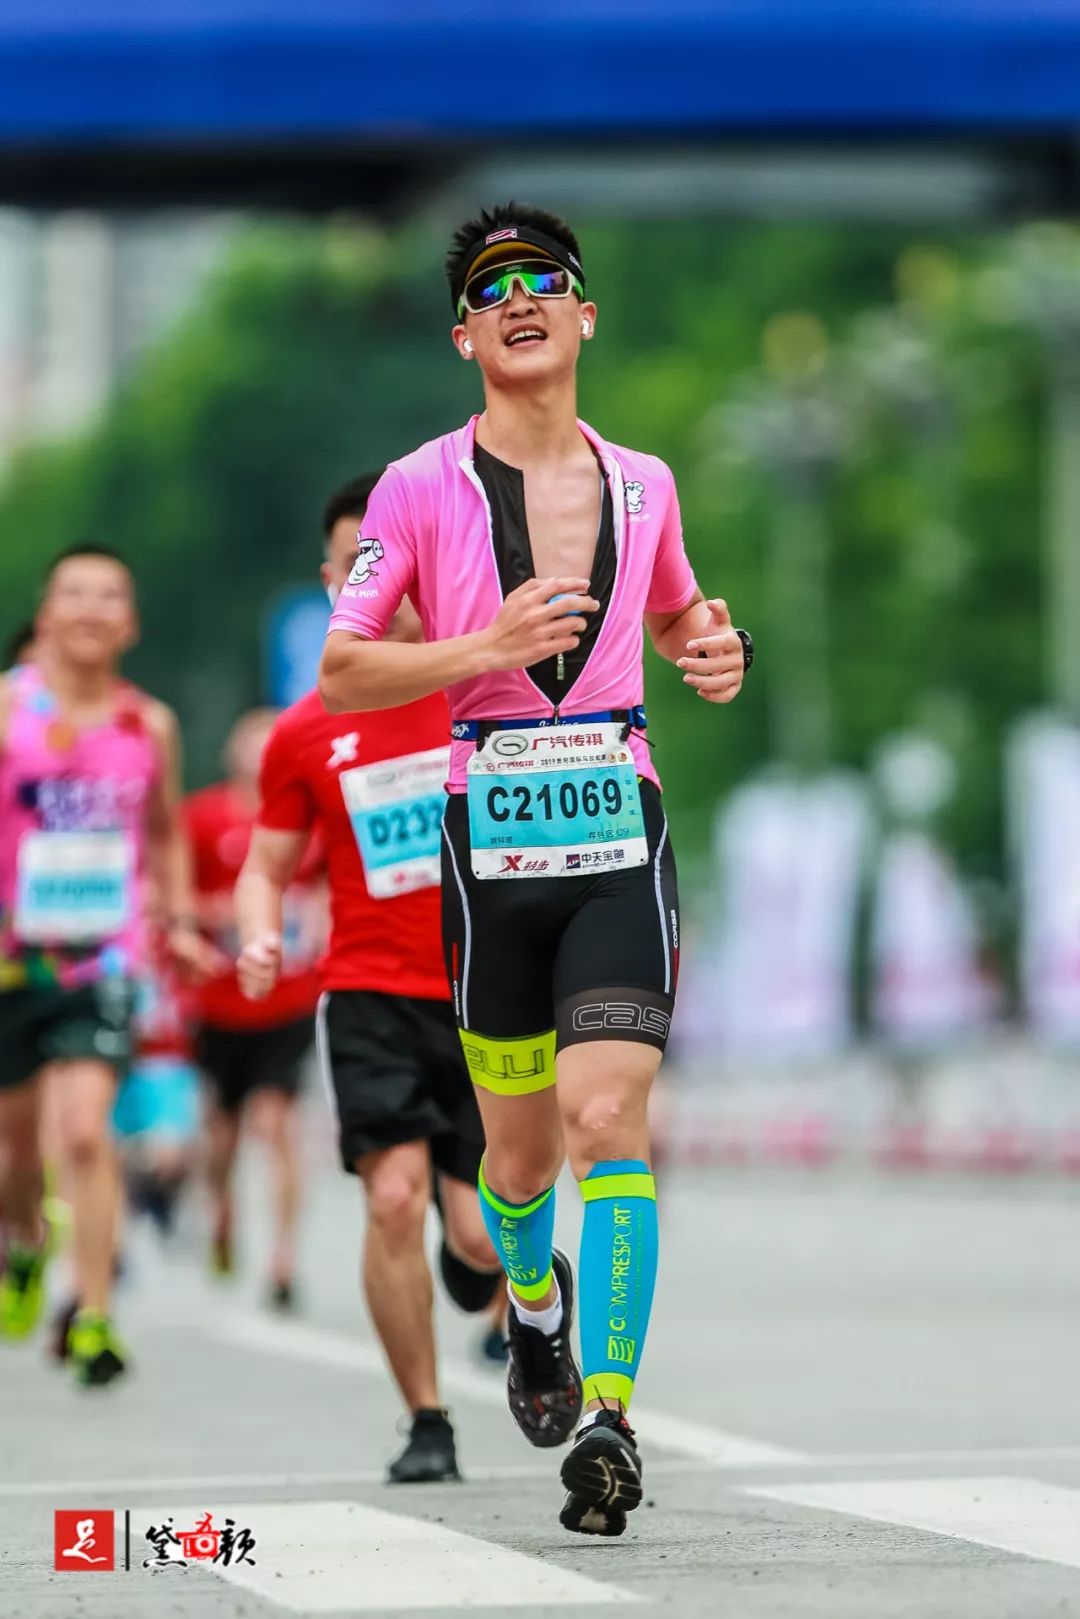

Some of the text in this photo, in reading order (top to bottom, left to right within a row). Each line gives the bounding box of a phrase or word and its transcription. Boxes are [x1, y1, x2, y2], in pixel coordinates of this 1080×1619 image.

[531, 732, 605, 751] 广汽传祺
[486, 777, 622, 823] C21069
[523, 859, 551, 872] 特步
[581, 848, 625, 864] 中天金融
[608, 1208, 632, 1332] COMPRESSPORT
